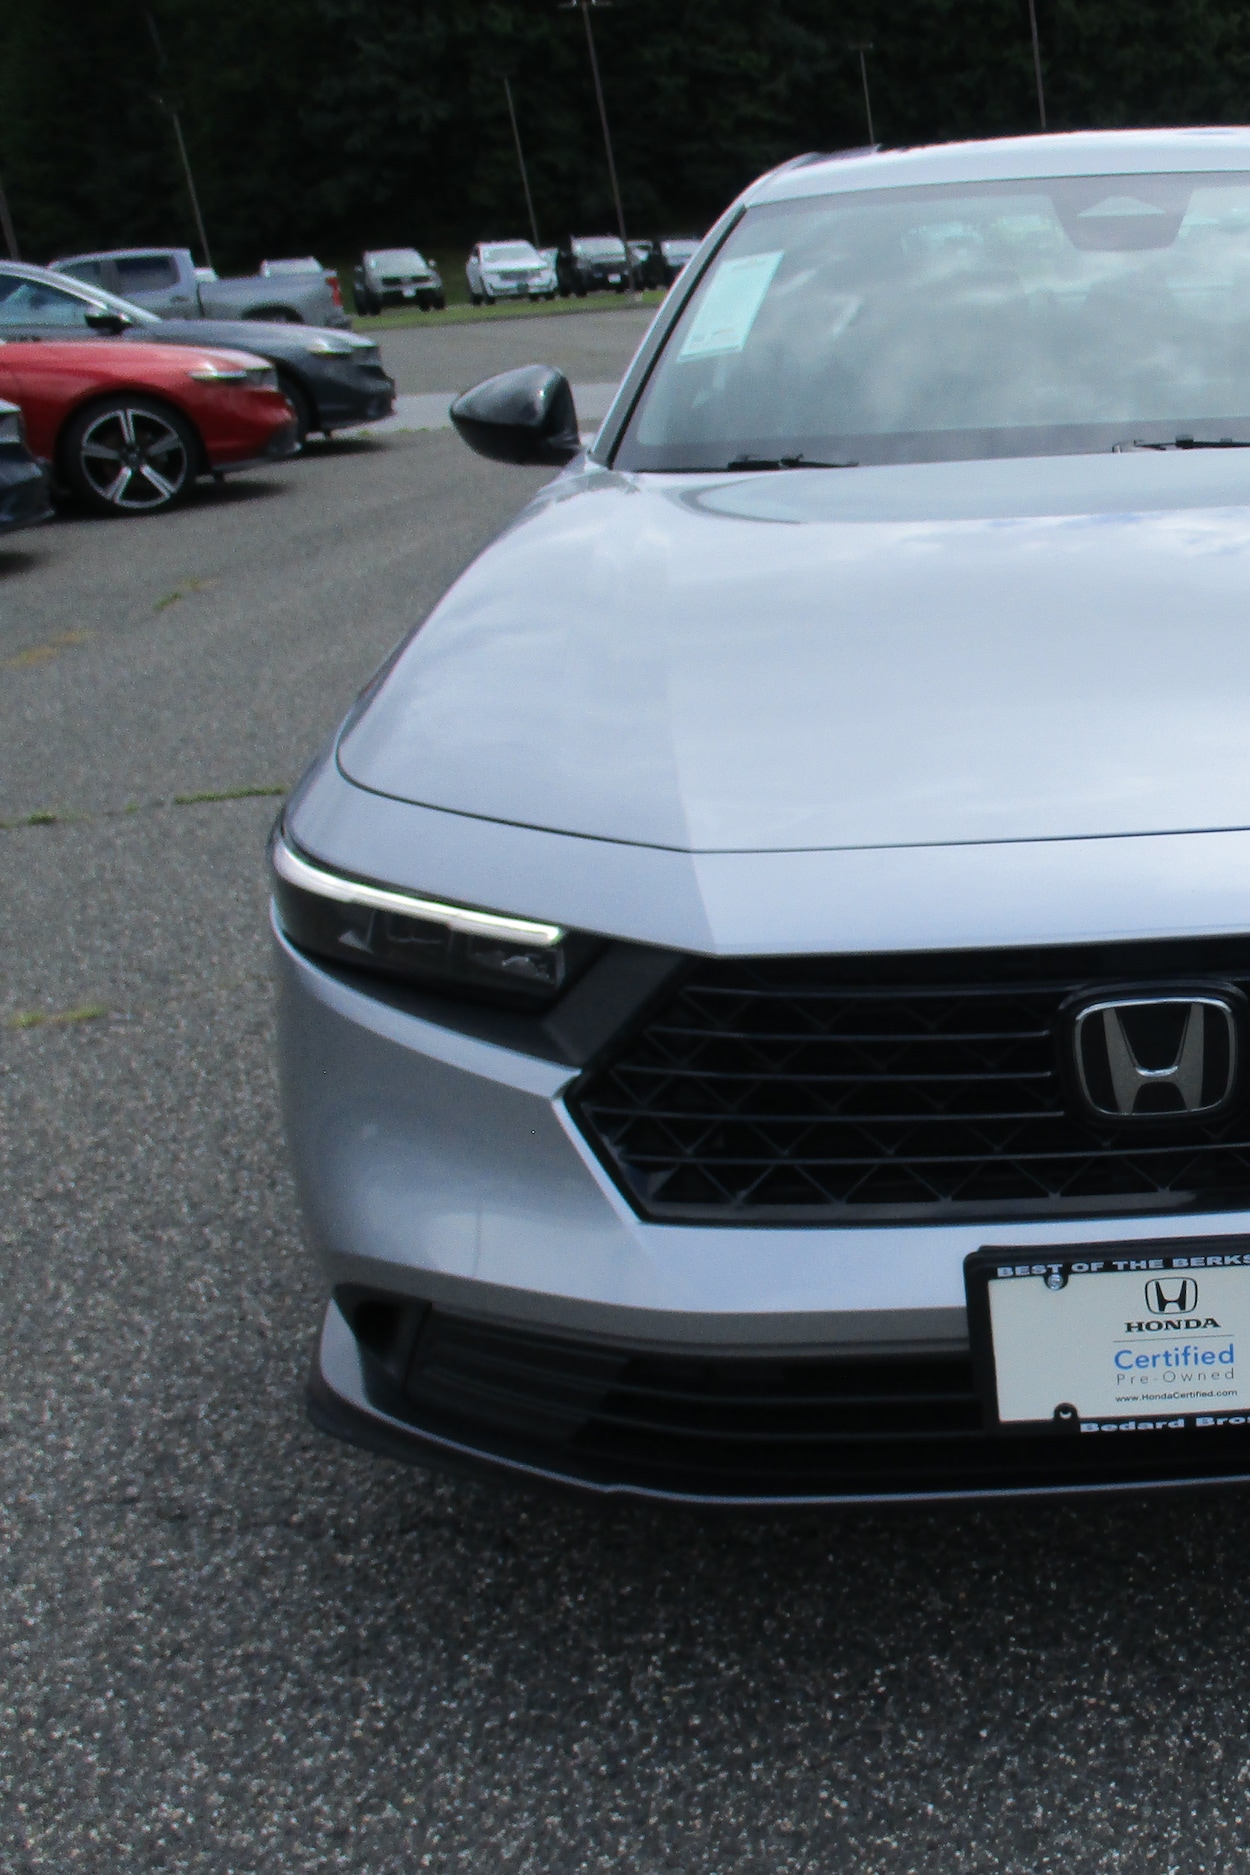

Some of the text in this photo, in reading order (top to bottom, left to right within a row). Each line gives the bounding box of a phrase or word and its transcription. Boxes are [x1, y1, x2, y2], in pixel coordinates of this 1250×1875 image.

[997, 1263, 1064, 1278] BEST
[1071, 1261, 1104, 1274] OF
[1112, 1258, 1164, 1271] THE
[1125, 1317, 1222, 1333] HONDA
[1114, 1343, 1235, 1371] Certified
[1116, 1367, 1235, 1386] Pre-Owned
[1115, 1389, 1238, 1403] www.HondaCertified.com
